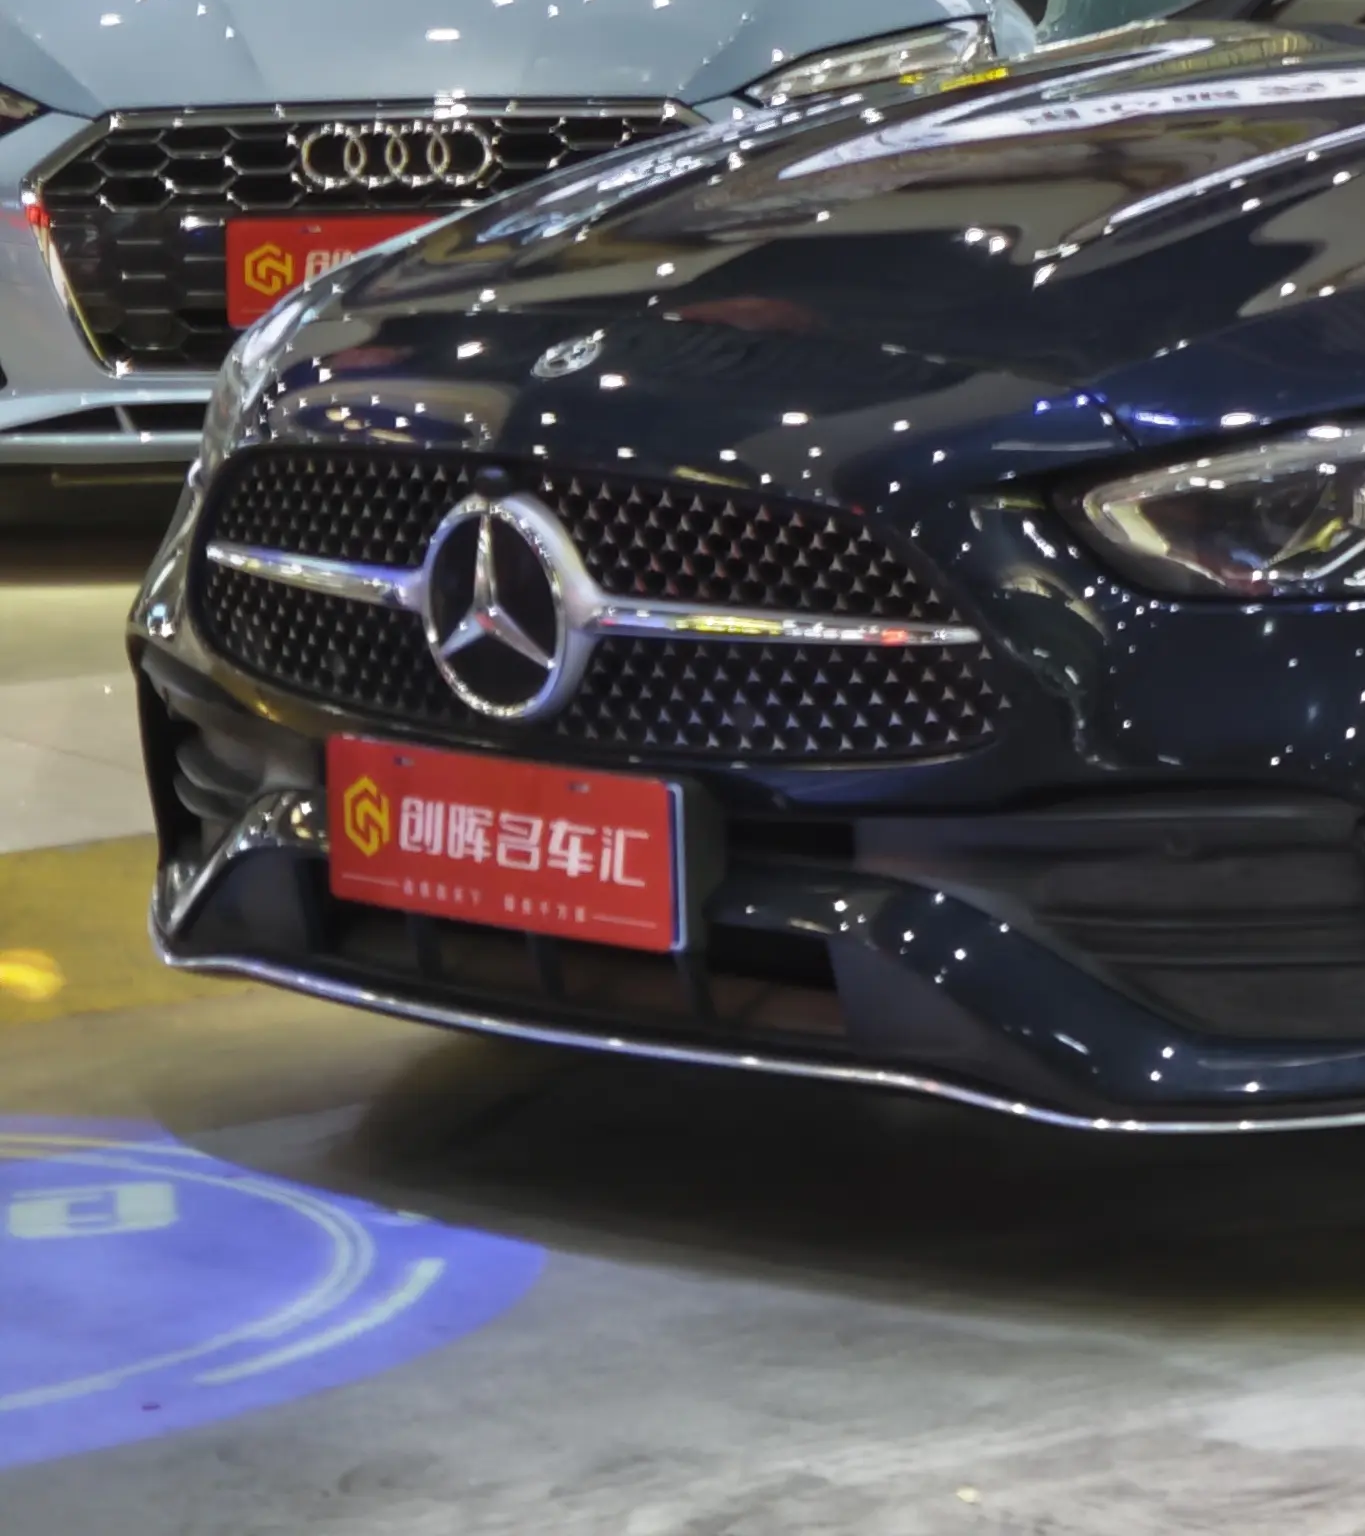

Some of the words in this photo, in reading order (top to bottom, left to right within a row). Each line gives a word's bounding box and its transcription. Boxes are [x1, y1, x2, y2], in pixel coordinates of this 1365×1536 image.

[399, 796, 651, 887] 创晖名车汇
